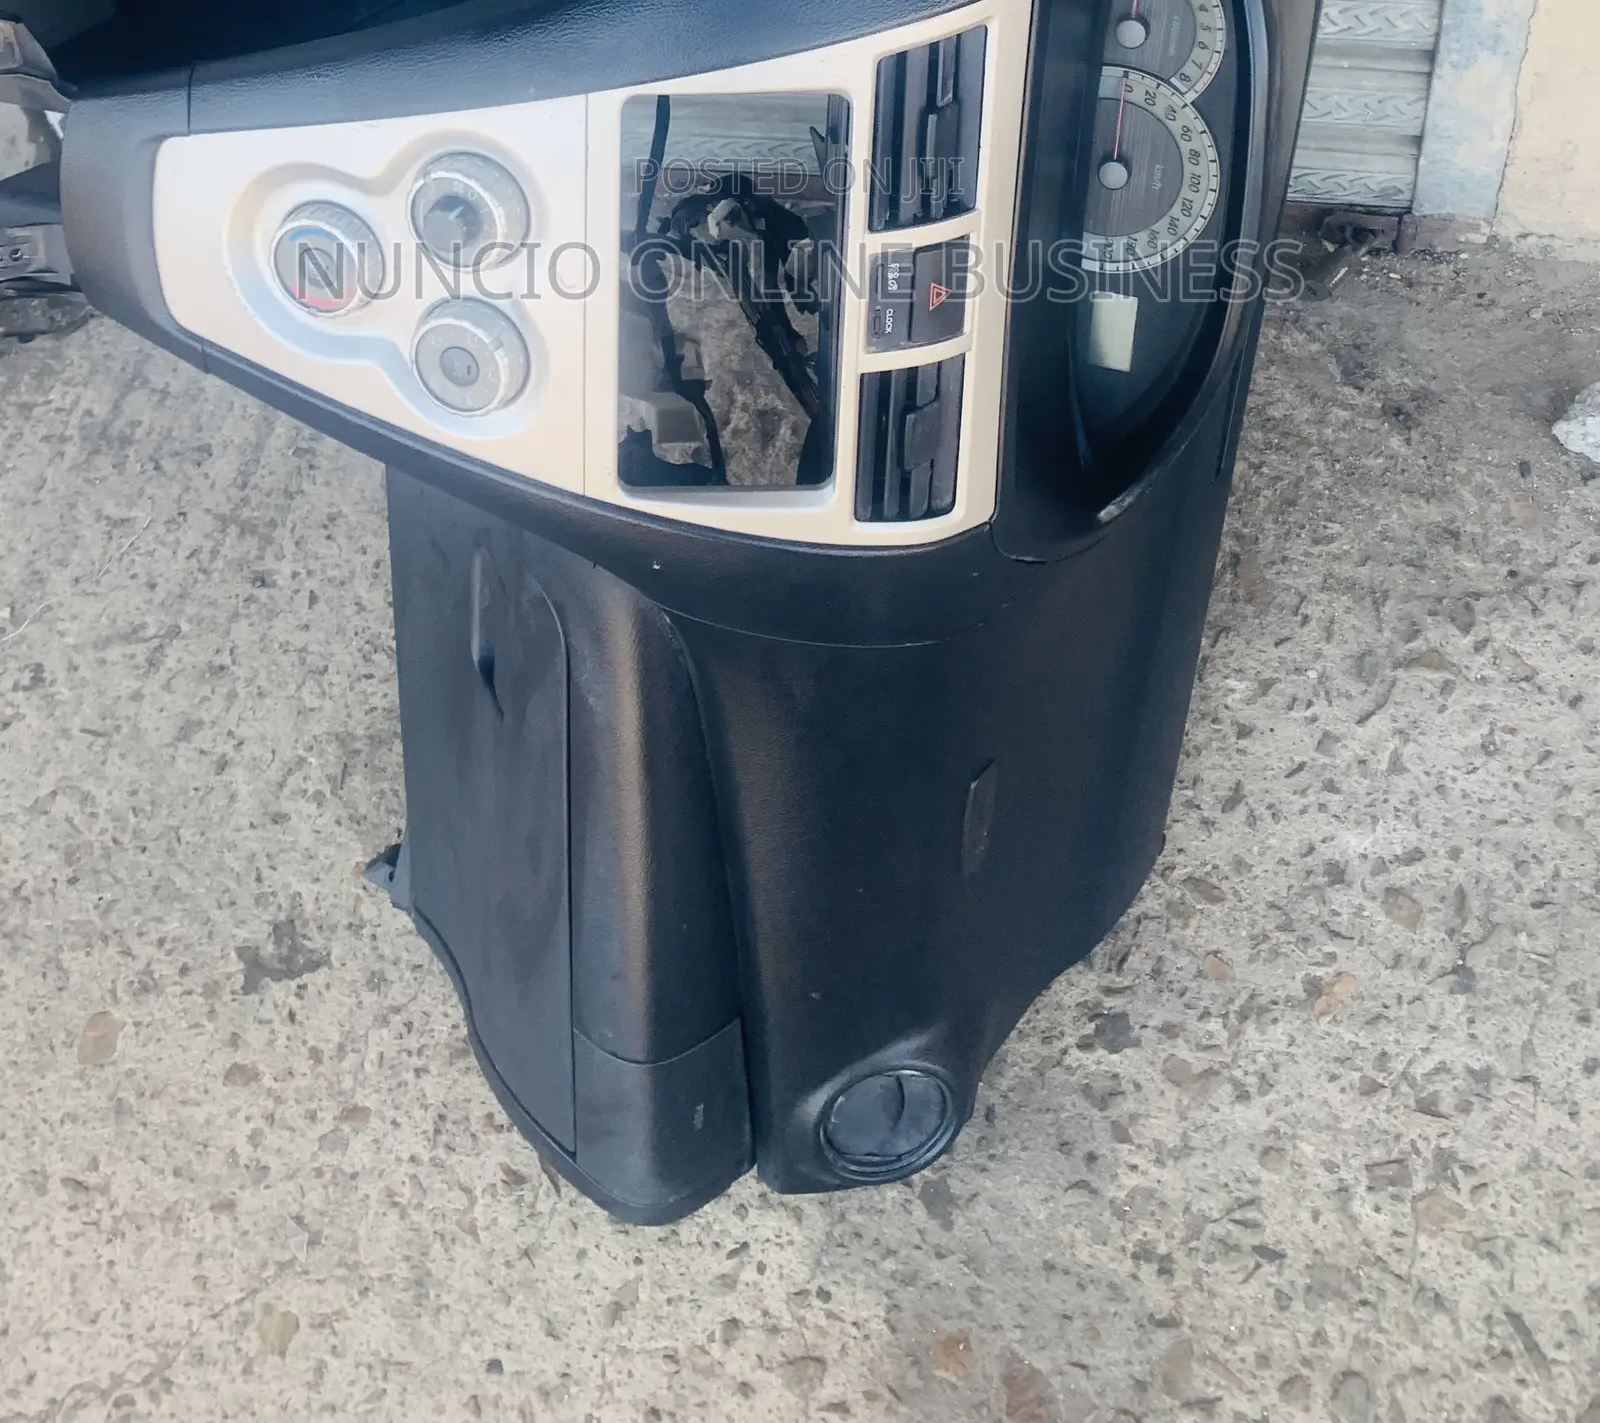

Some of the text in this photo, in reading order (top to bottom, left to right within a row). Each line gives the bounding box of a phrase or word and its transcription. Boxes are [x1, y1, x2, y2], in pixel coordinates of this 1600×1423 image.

[1198, 3, 1210, 13] 4
[1200, 22, 1212, 33] 5
[1197, 40, 1210, 51] 6
[1191, 58, 1203, 71] 7
[1179, 72, 1192, 83] 8
[1144, 89, 1157, 107] 20
[1164, 104, 1177, 121] 40
[1180, 124, 1192, 142] 60
[1187, 148, 1201, 166] 80
[1188, 172, 1201, 194] 100
[1180, 197, 1194, 218] 120
[1167, 215, 1180, 236] 140
[884, 308, 894, 334] CLOCK
